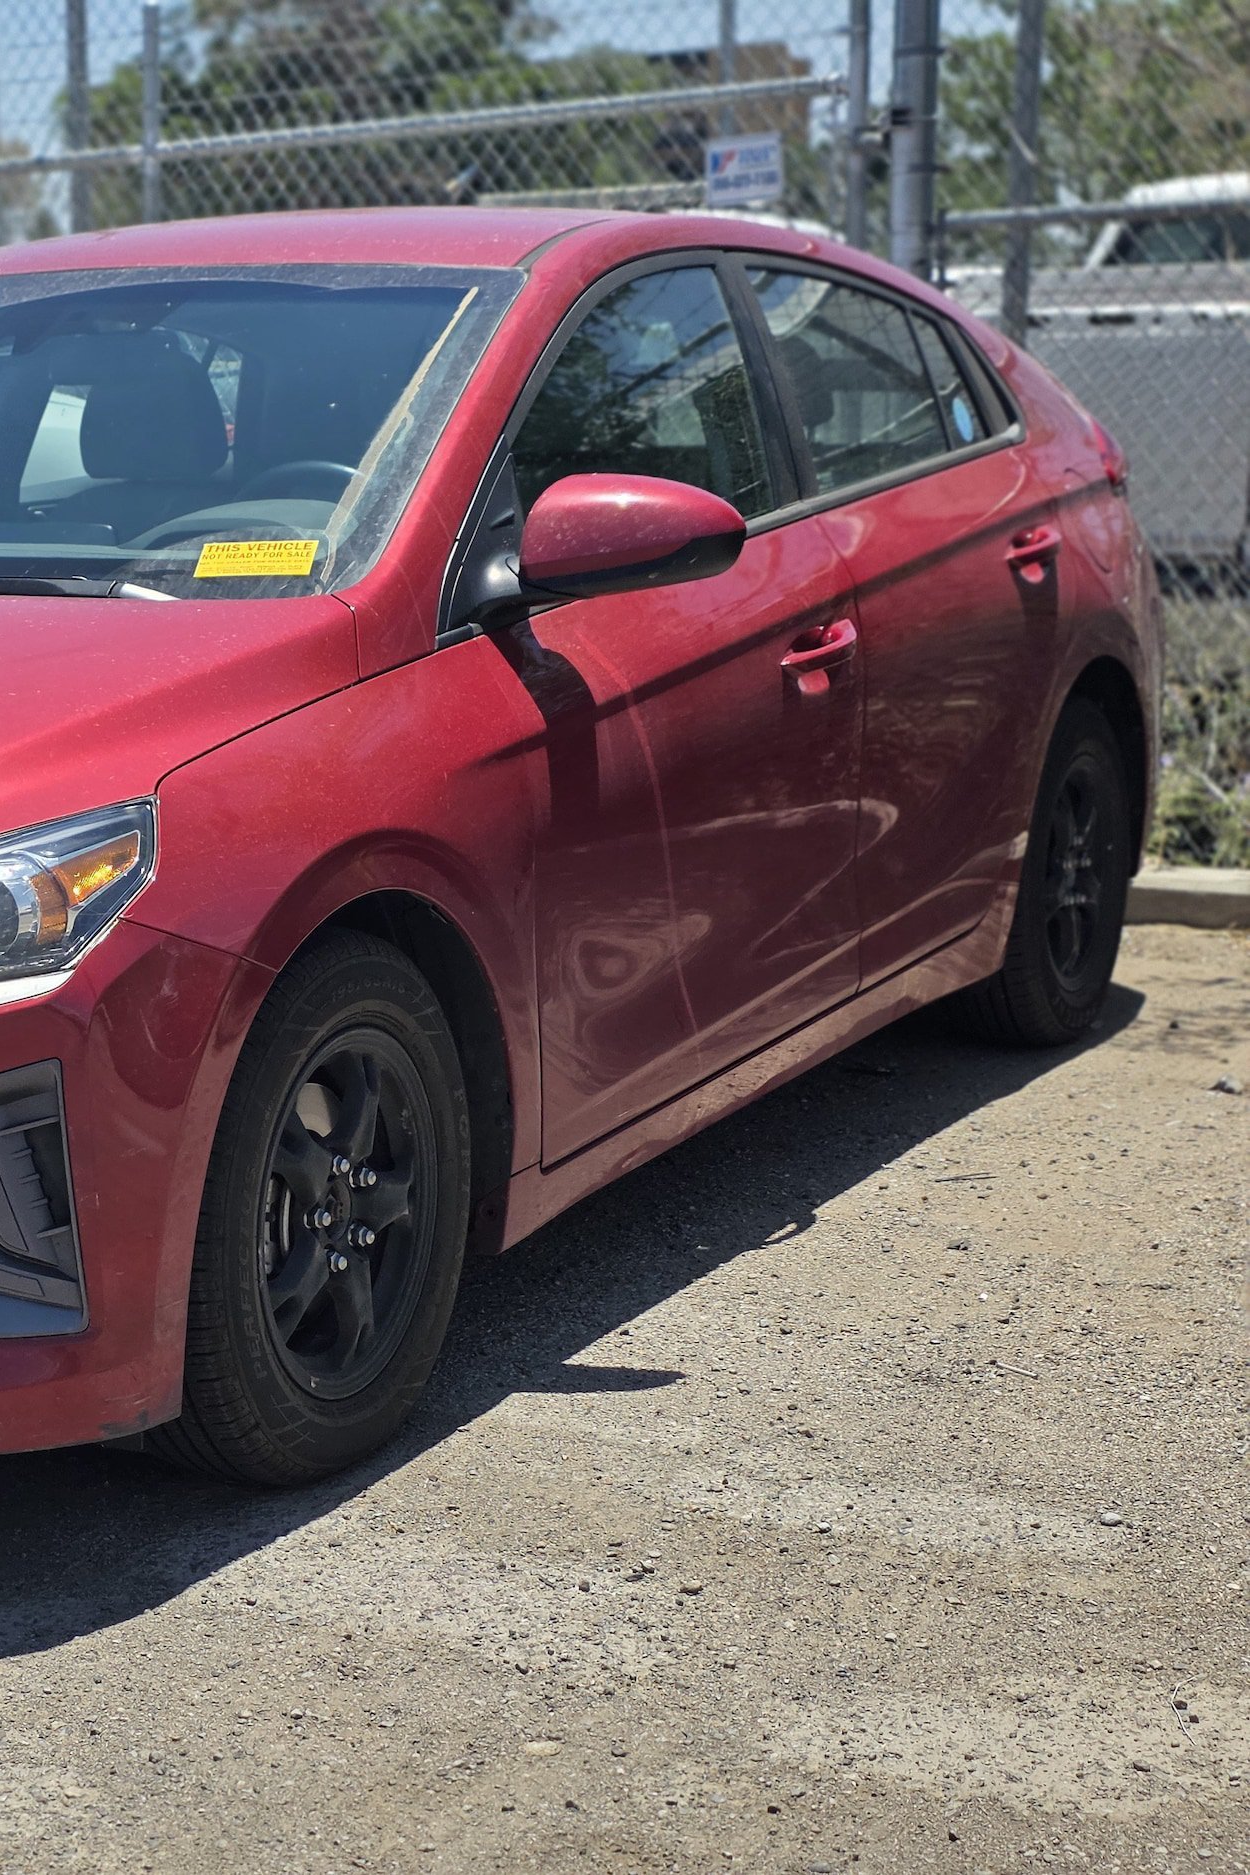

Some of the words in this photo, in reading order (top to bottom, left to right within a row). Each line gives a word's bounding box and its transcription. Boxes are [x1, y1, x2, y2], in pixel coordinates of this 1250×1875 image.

[207, 543, 241, 553] THIS
[247, 541, 314, 552] VEHICLE
[286, 550, 312, 558] SALE
